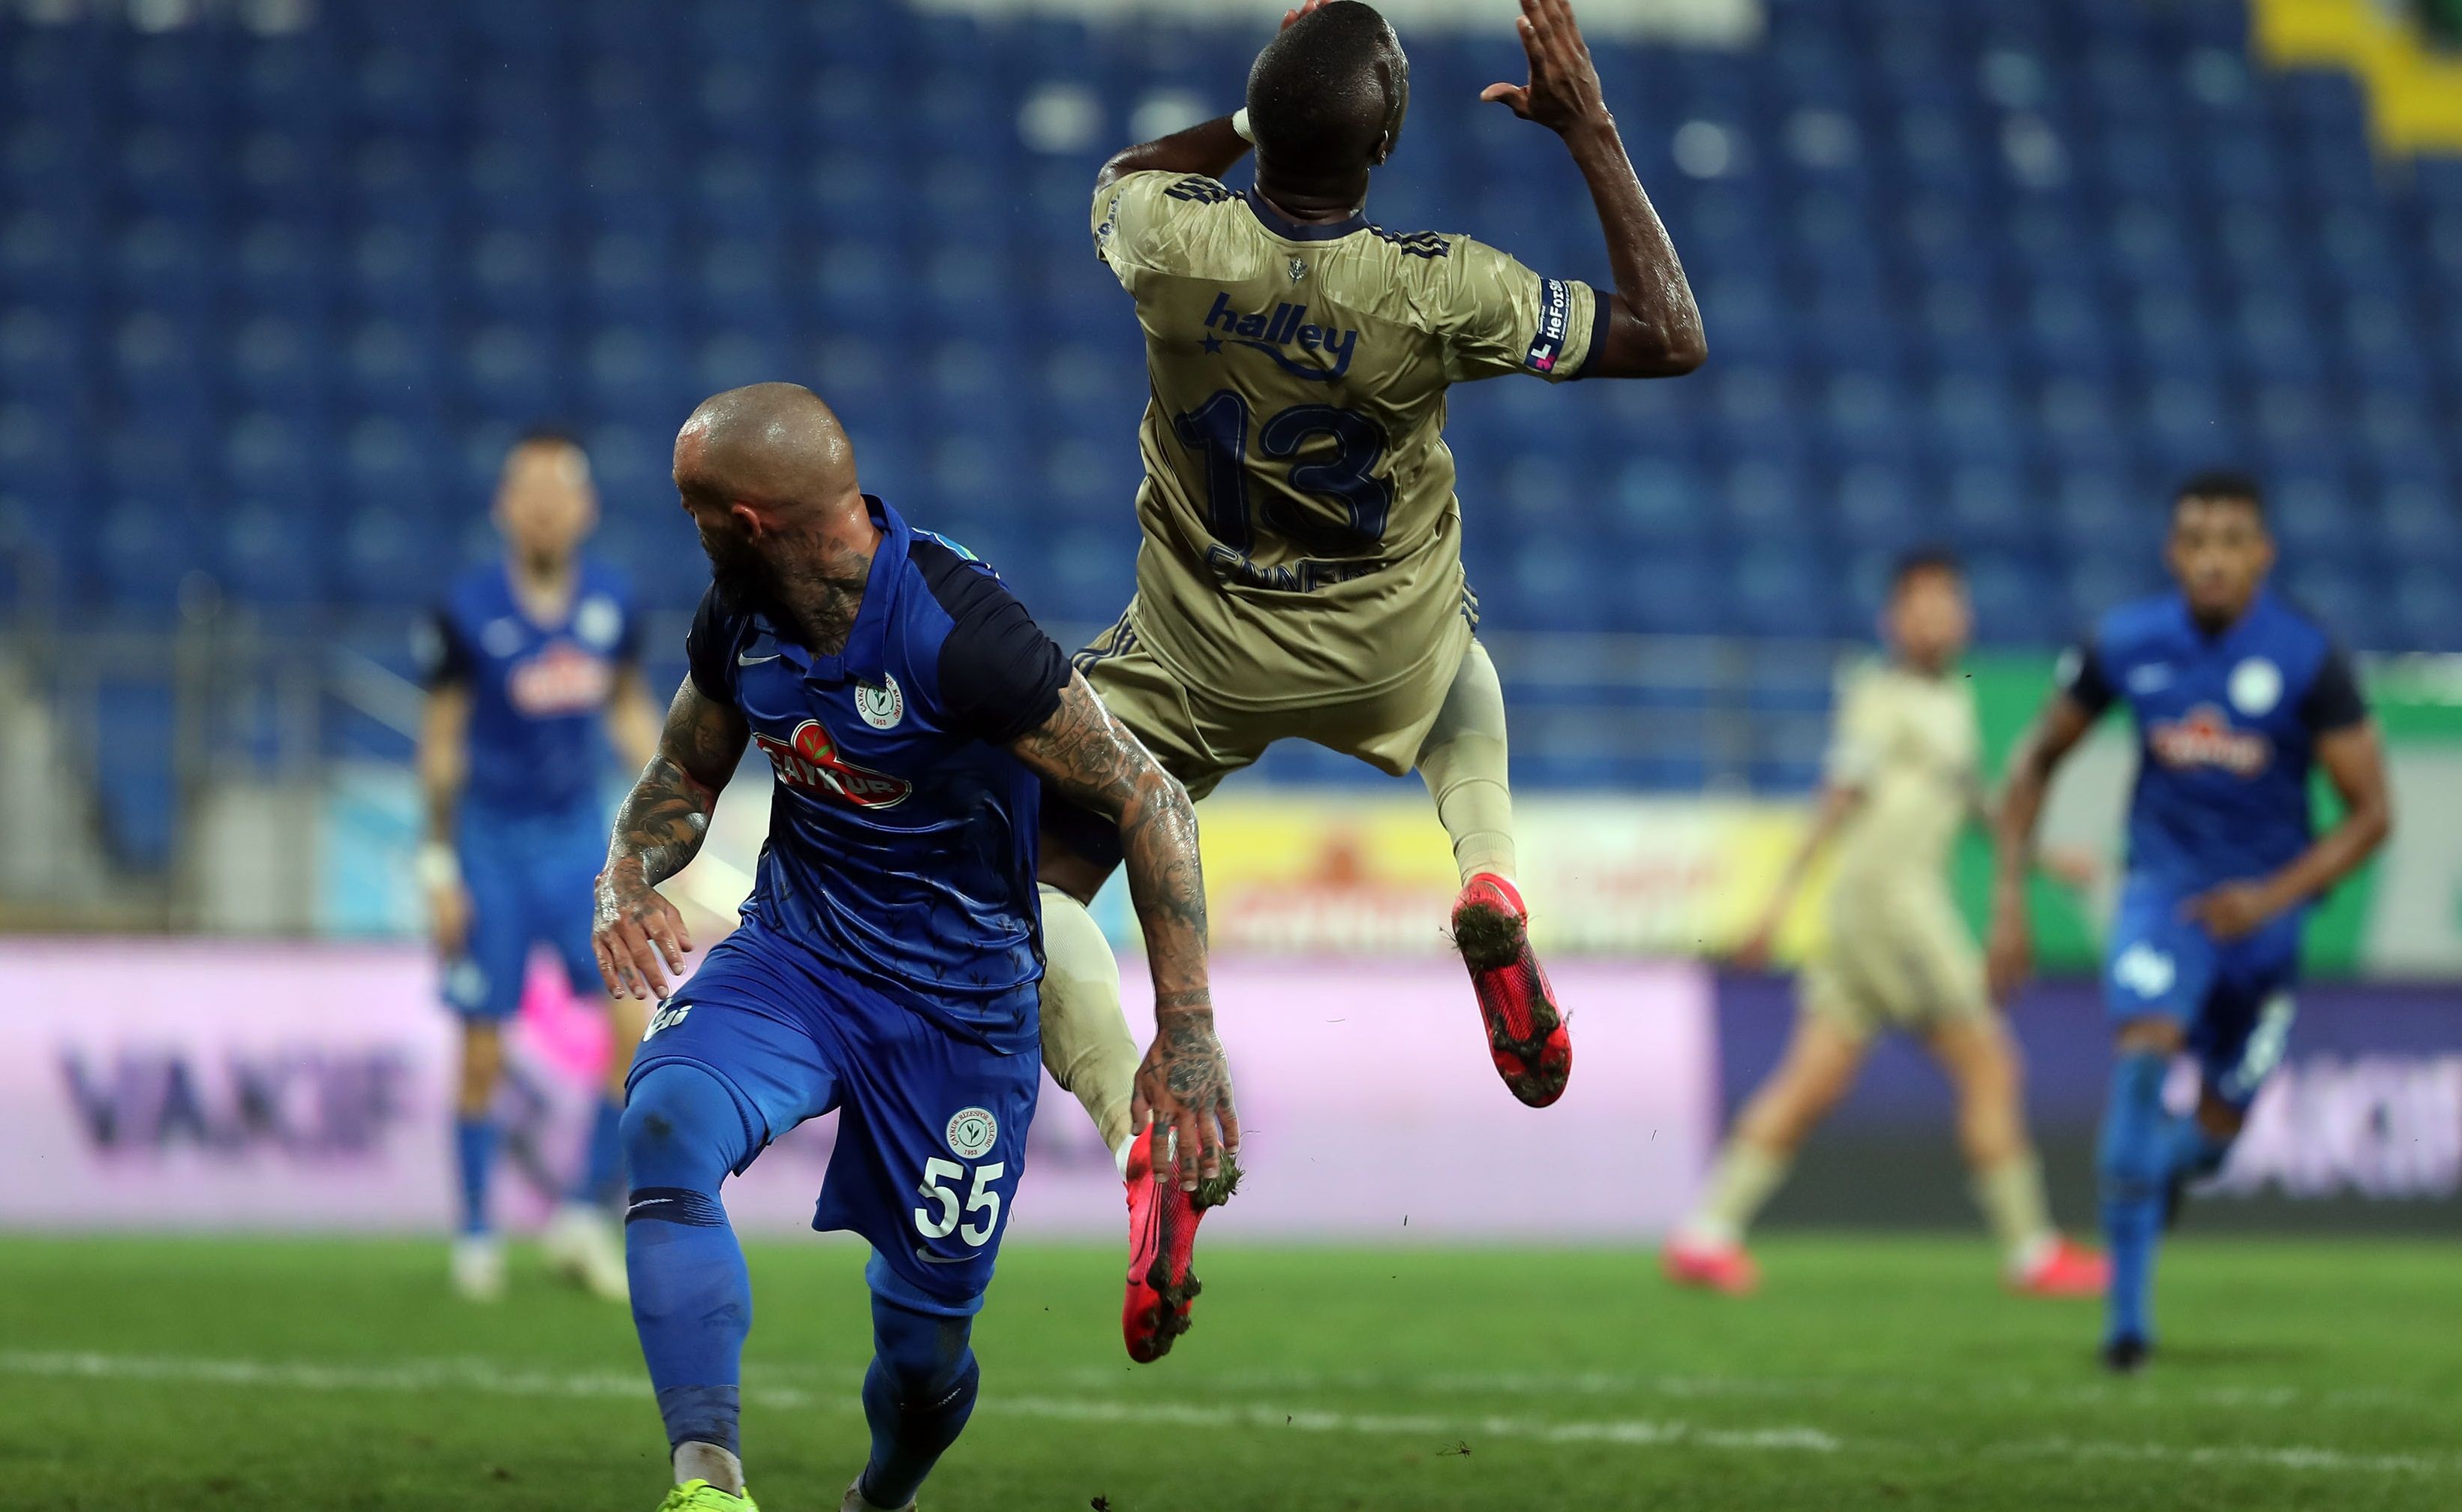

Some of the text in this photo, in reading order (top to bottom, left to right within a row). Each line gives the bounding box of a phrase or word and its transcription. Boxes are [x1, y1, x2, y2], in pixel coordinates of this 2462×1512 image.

[1204, 290, 1357, 382] halley
[1173, 389, 1393, 557] 13
[914, 1156, 1005, 1247] 55
